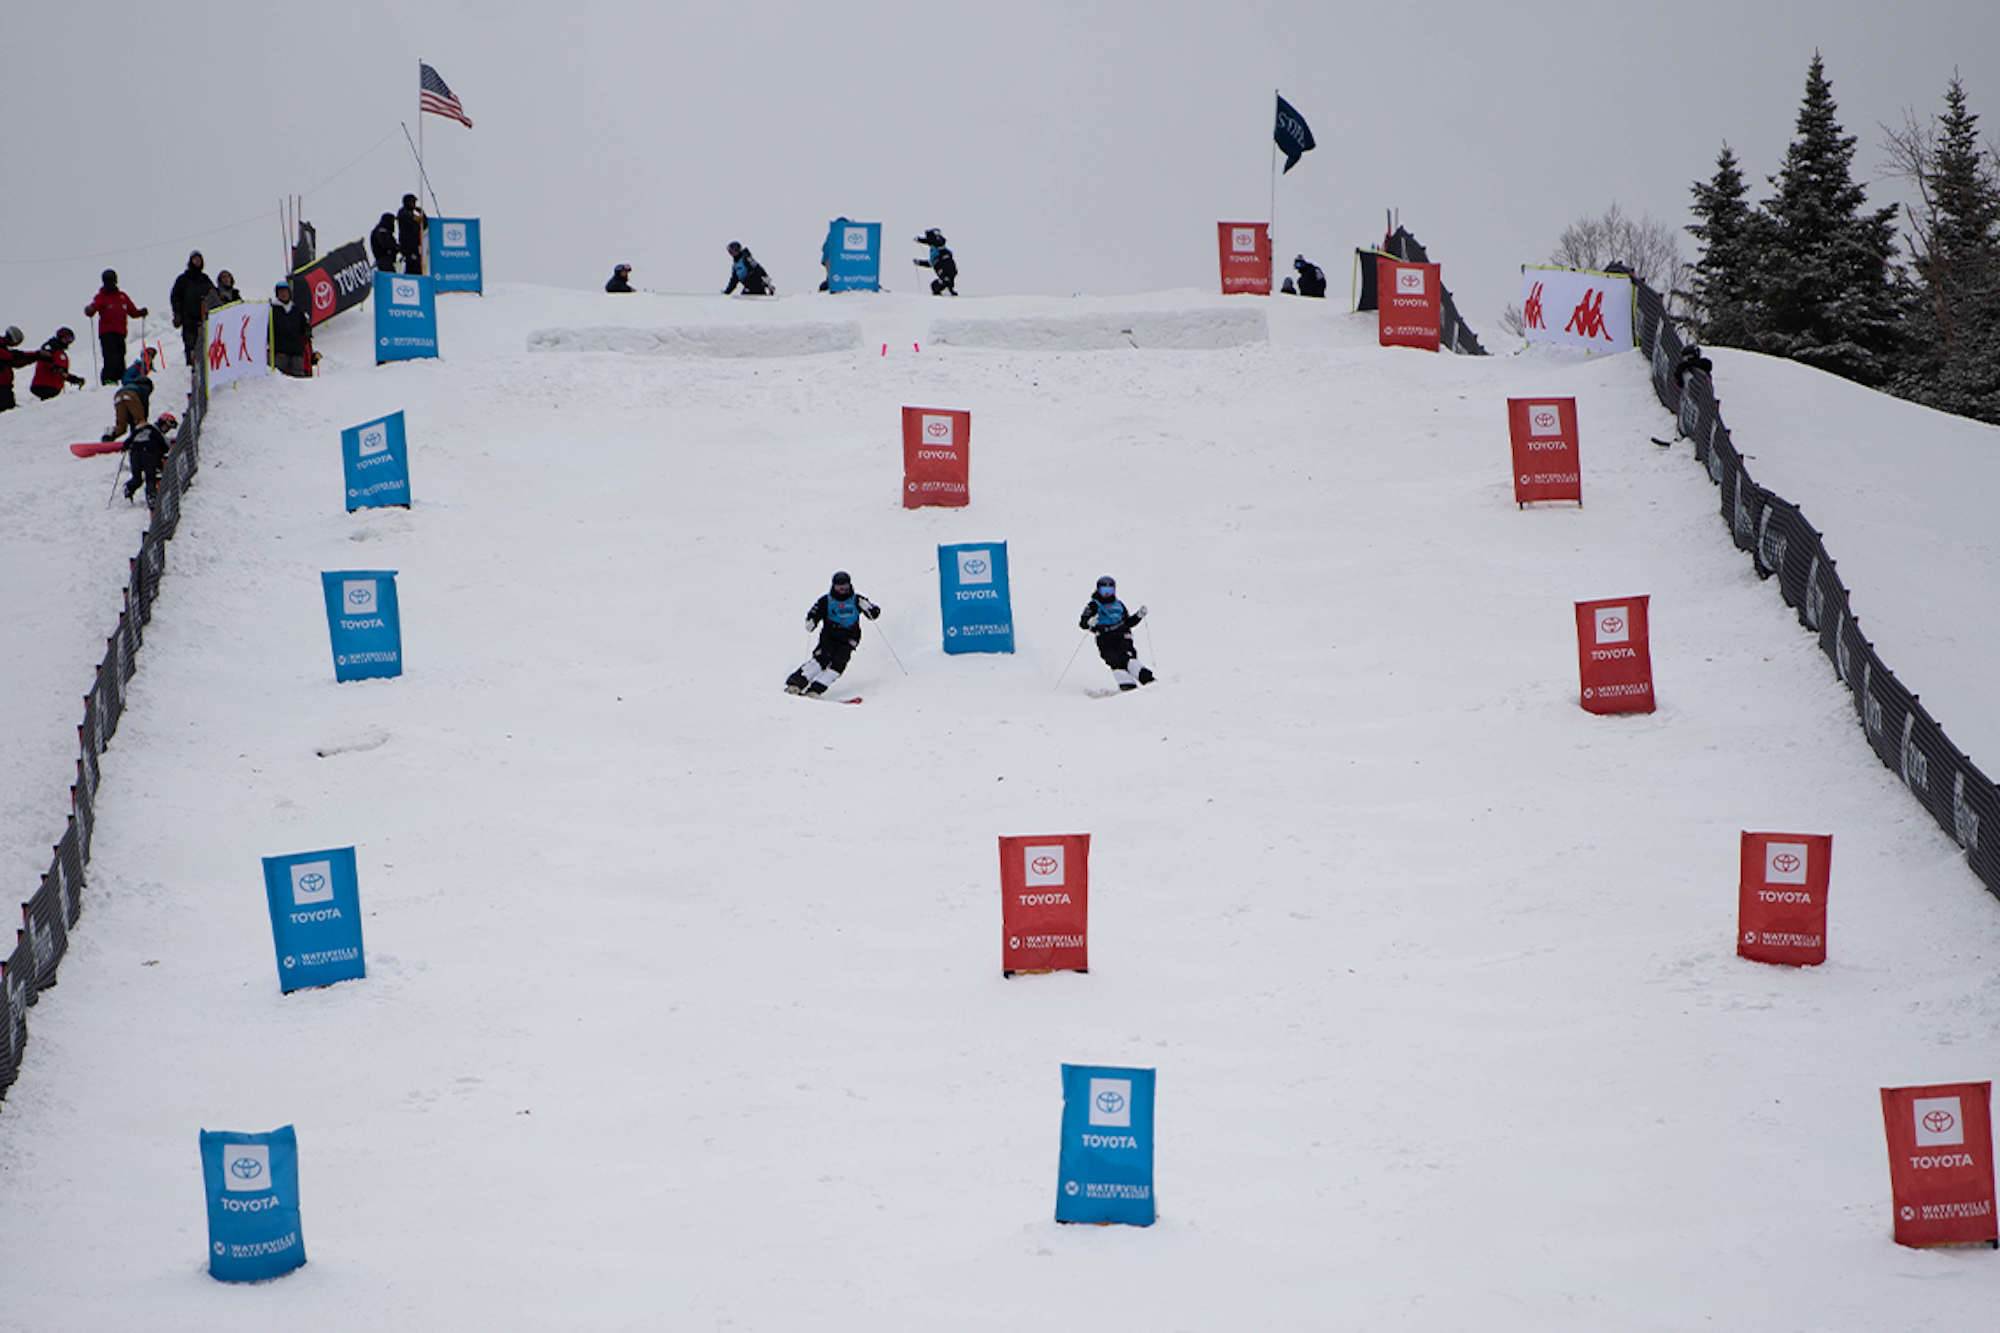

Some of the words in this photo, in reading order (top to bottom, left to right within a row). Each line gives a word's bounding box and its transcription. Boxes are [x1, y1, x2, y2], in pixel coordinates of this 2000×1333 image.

[333, 260, 371, 296] TOYOTA
[1393, 299, 1429, 308] TOYOTA
[388, 309, 425, 319] TOYOTA
[1528, 441, 1567, 451] TOYOTA
[918, 450, 958, 460] TOYOTA
[356, 454, 394, 470] TOYOTA
[955, 590, 999, 600] TOYOTA
[340, 618, 385, 630] TOYOTA
[1591, 648, 1636, 660] TOYOTA
[1019, 894, 1071, 906] TOYOTA
[1757, 890, 1812, 904] TOYOTA
[290, 908, 342, 924] TOYOTA
[1026, 935, 1083, 943] WATERVILLE
[1762, 932, 1820, 941] WATERVILLE
[301, 947, 358, 960] WATERVILLE
[1082, 1134, 1138, 1149] TOYOTA
[1910, 1154, 1974, 1169] TOYOTA
[1086, 1183, 1149, 1192] WATERVILLE
[220, 1195, 280, 1212] TOYOTA
[1922, 1201, 1990, 1213] WATERVILLE
[231, 1232, 295, 1252] WATERVILLE
